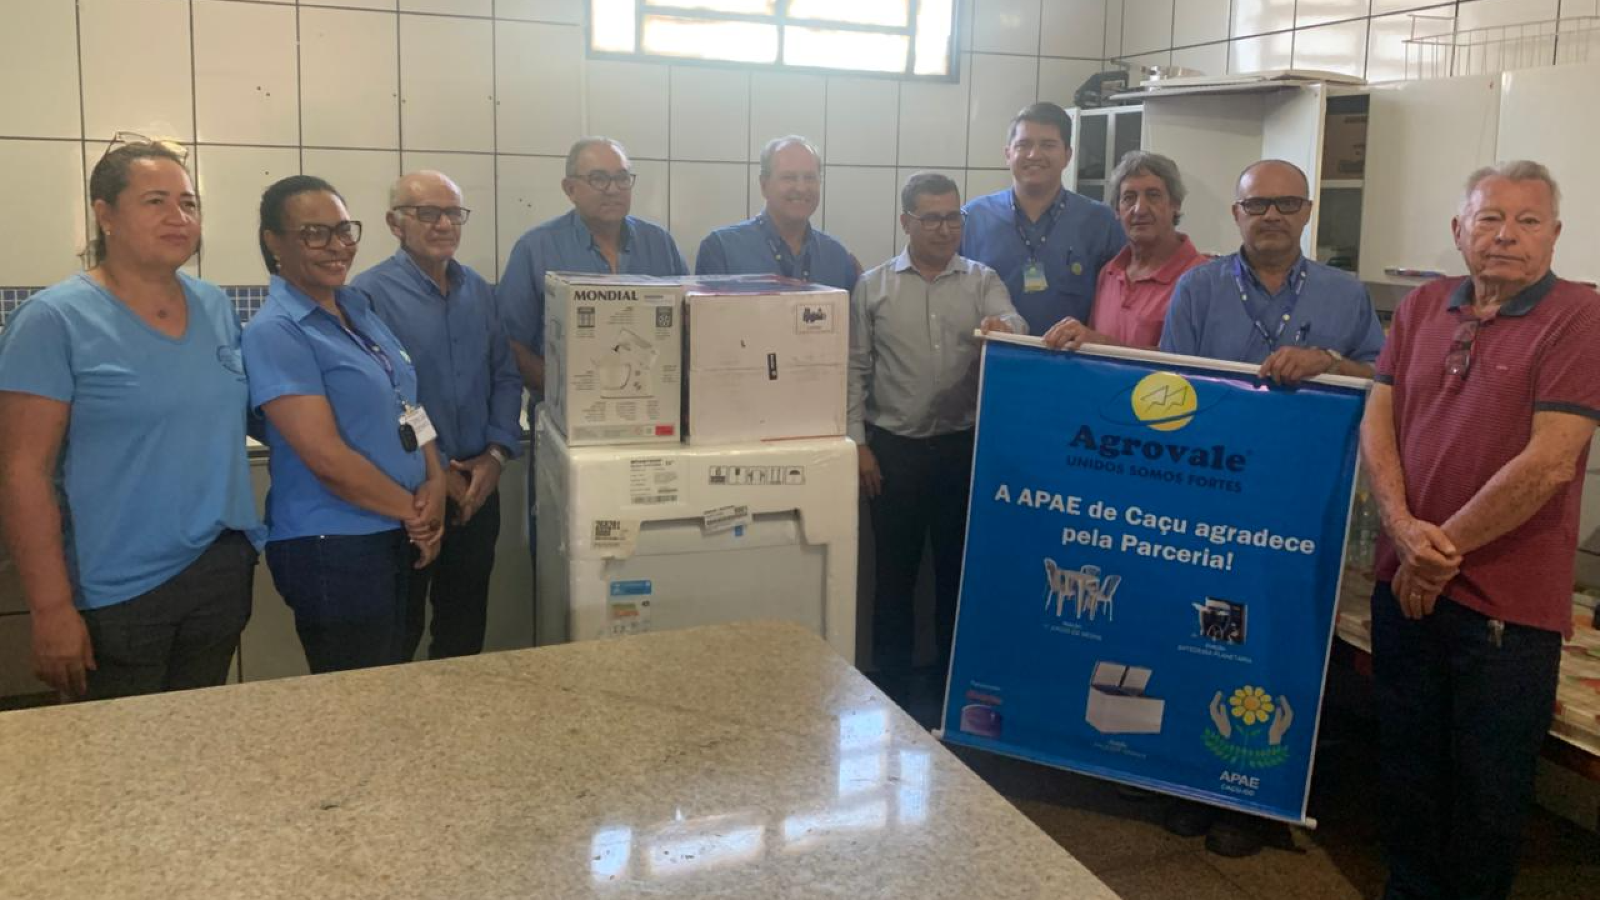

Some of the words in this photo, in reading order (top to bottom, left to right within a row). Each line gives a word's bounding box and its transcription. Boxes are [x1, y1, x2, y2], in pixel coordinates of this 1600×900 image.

[574, 290, 638, 301] MONDIAL
[1068, 425, 1246, 472] Agrovale
[1067, 455, 1124, 475] UNIDOS
[1130, 464, 1182, 485] SOMOS
[1188, 475, 1241, 493] FORTES
[994, 484, 1011, 502] A
[1017, 489, 1081, 516] APAE
[1089, 500, 1117, 521] de
[1125, 506, 1187, 535] Caçu
[1195, 523, 1316, 555] agradece
[1062, 527, 1112, 550] pela
[1121, 534, 1234, 571] Parceria!
[1219, 770, 1260, 790] APAE
